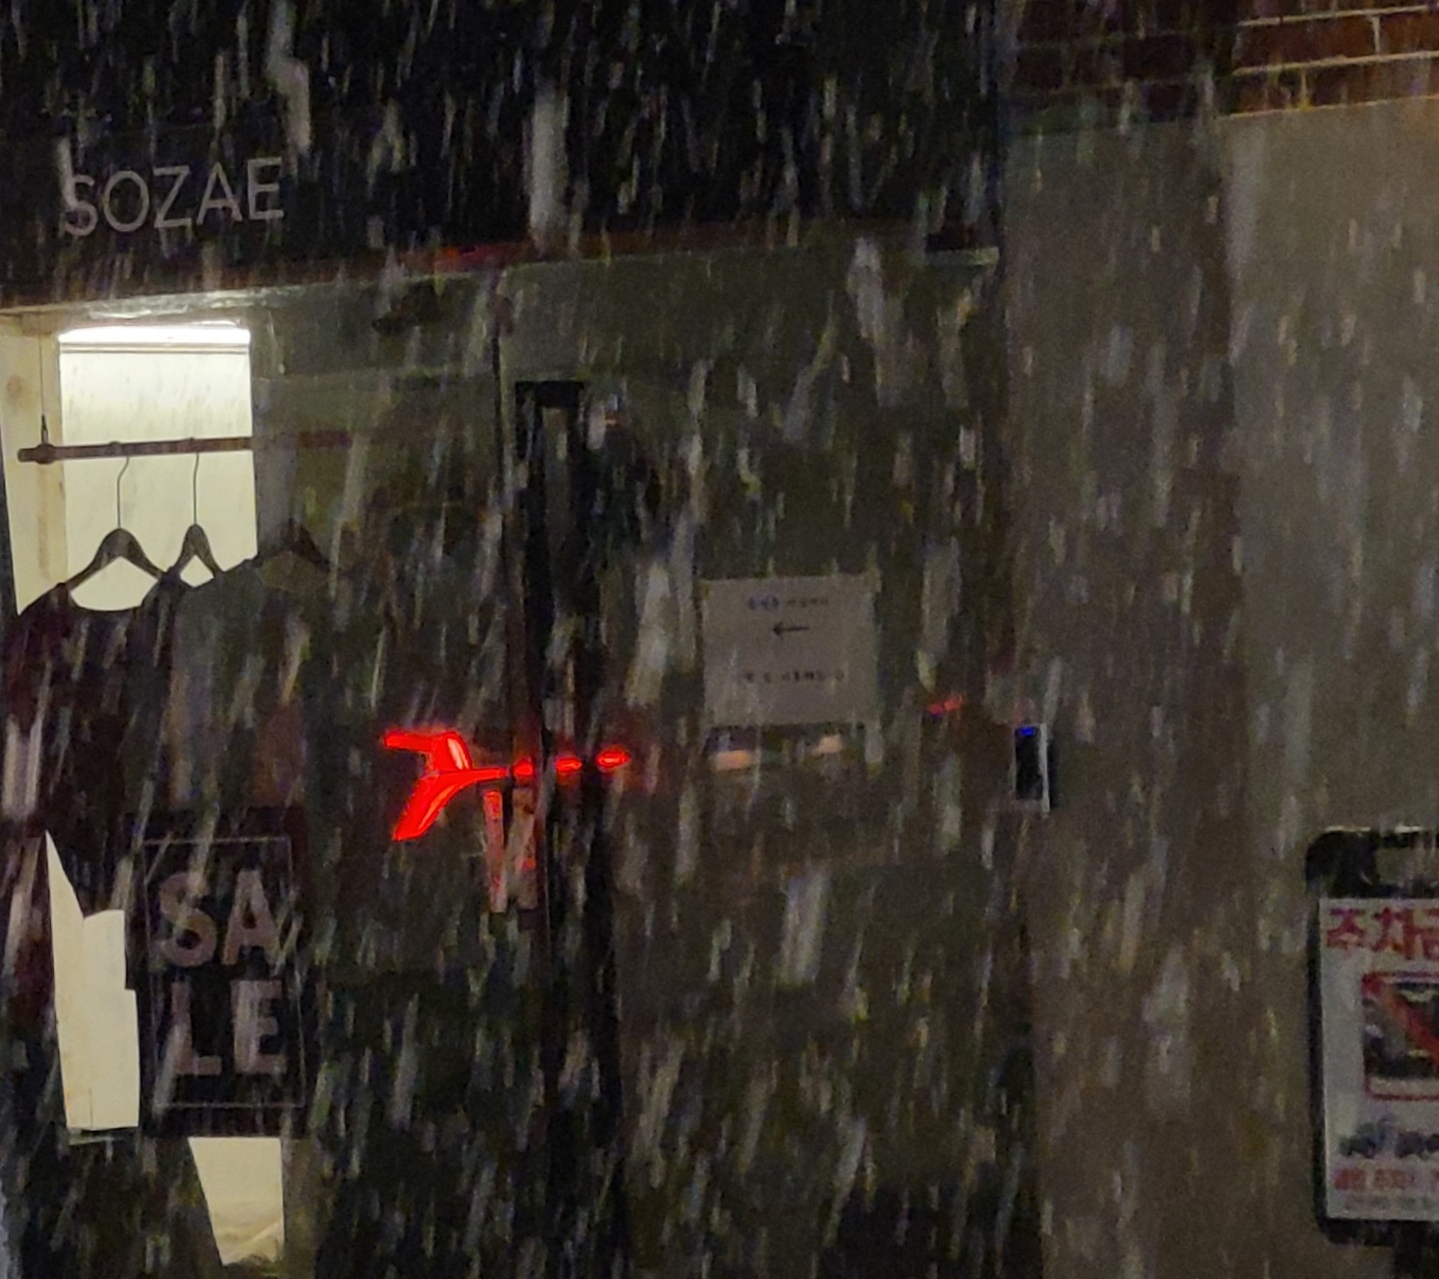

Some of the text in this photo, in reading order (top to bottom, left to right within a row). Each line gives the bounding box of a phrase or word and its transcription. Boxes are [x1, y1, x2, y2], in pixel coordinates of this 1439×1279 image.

[63, 156, 285, 237] SOZAE
[158, 868, 282, 967] SA
[171, 979, 288, 1076] LE
